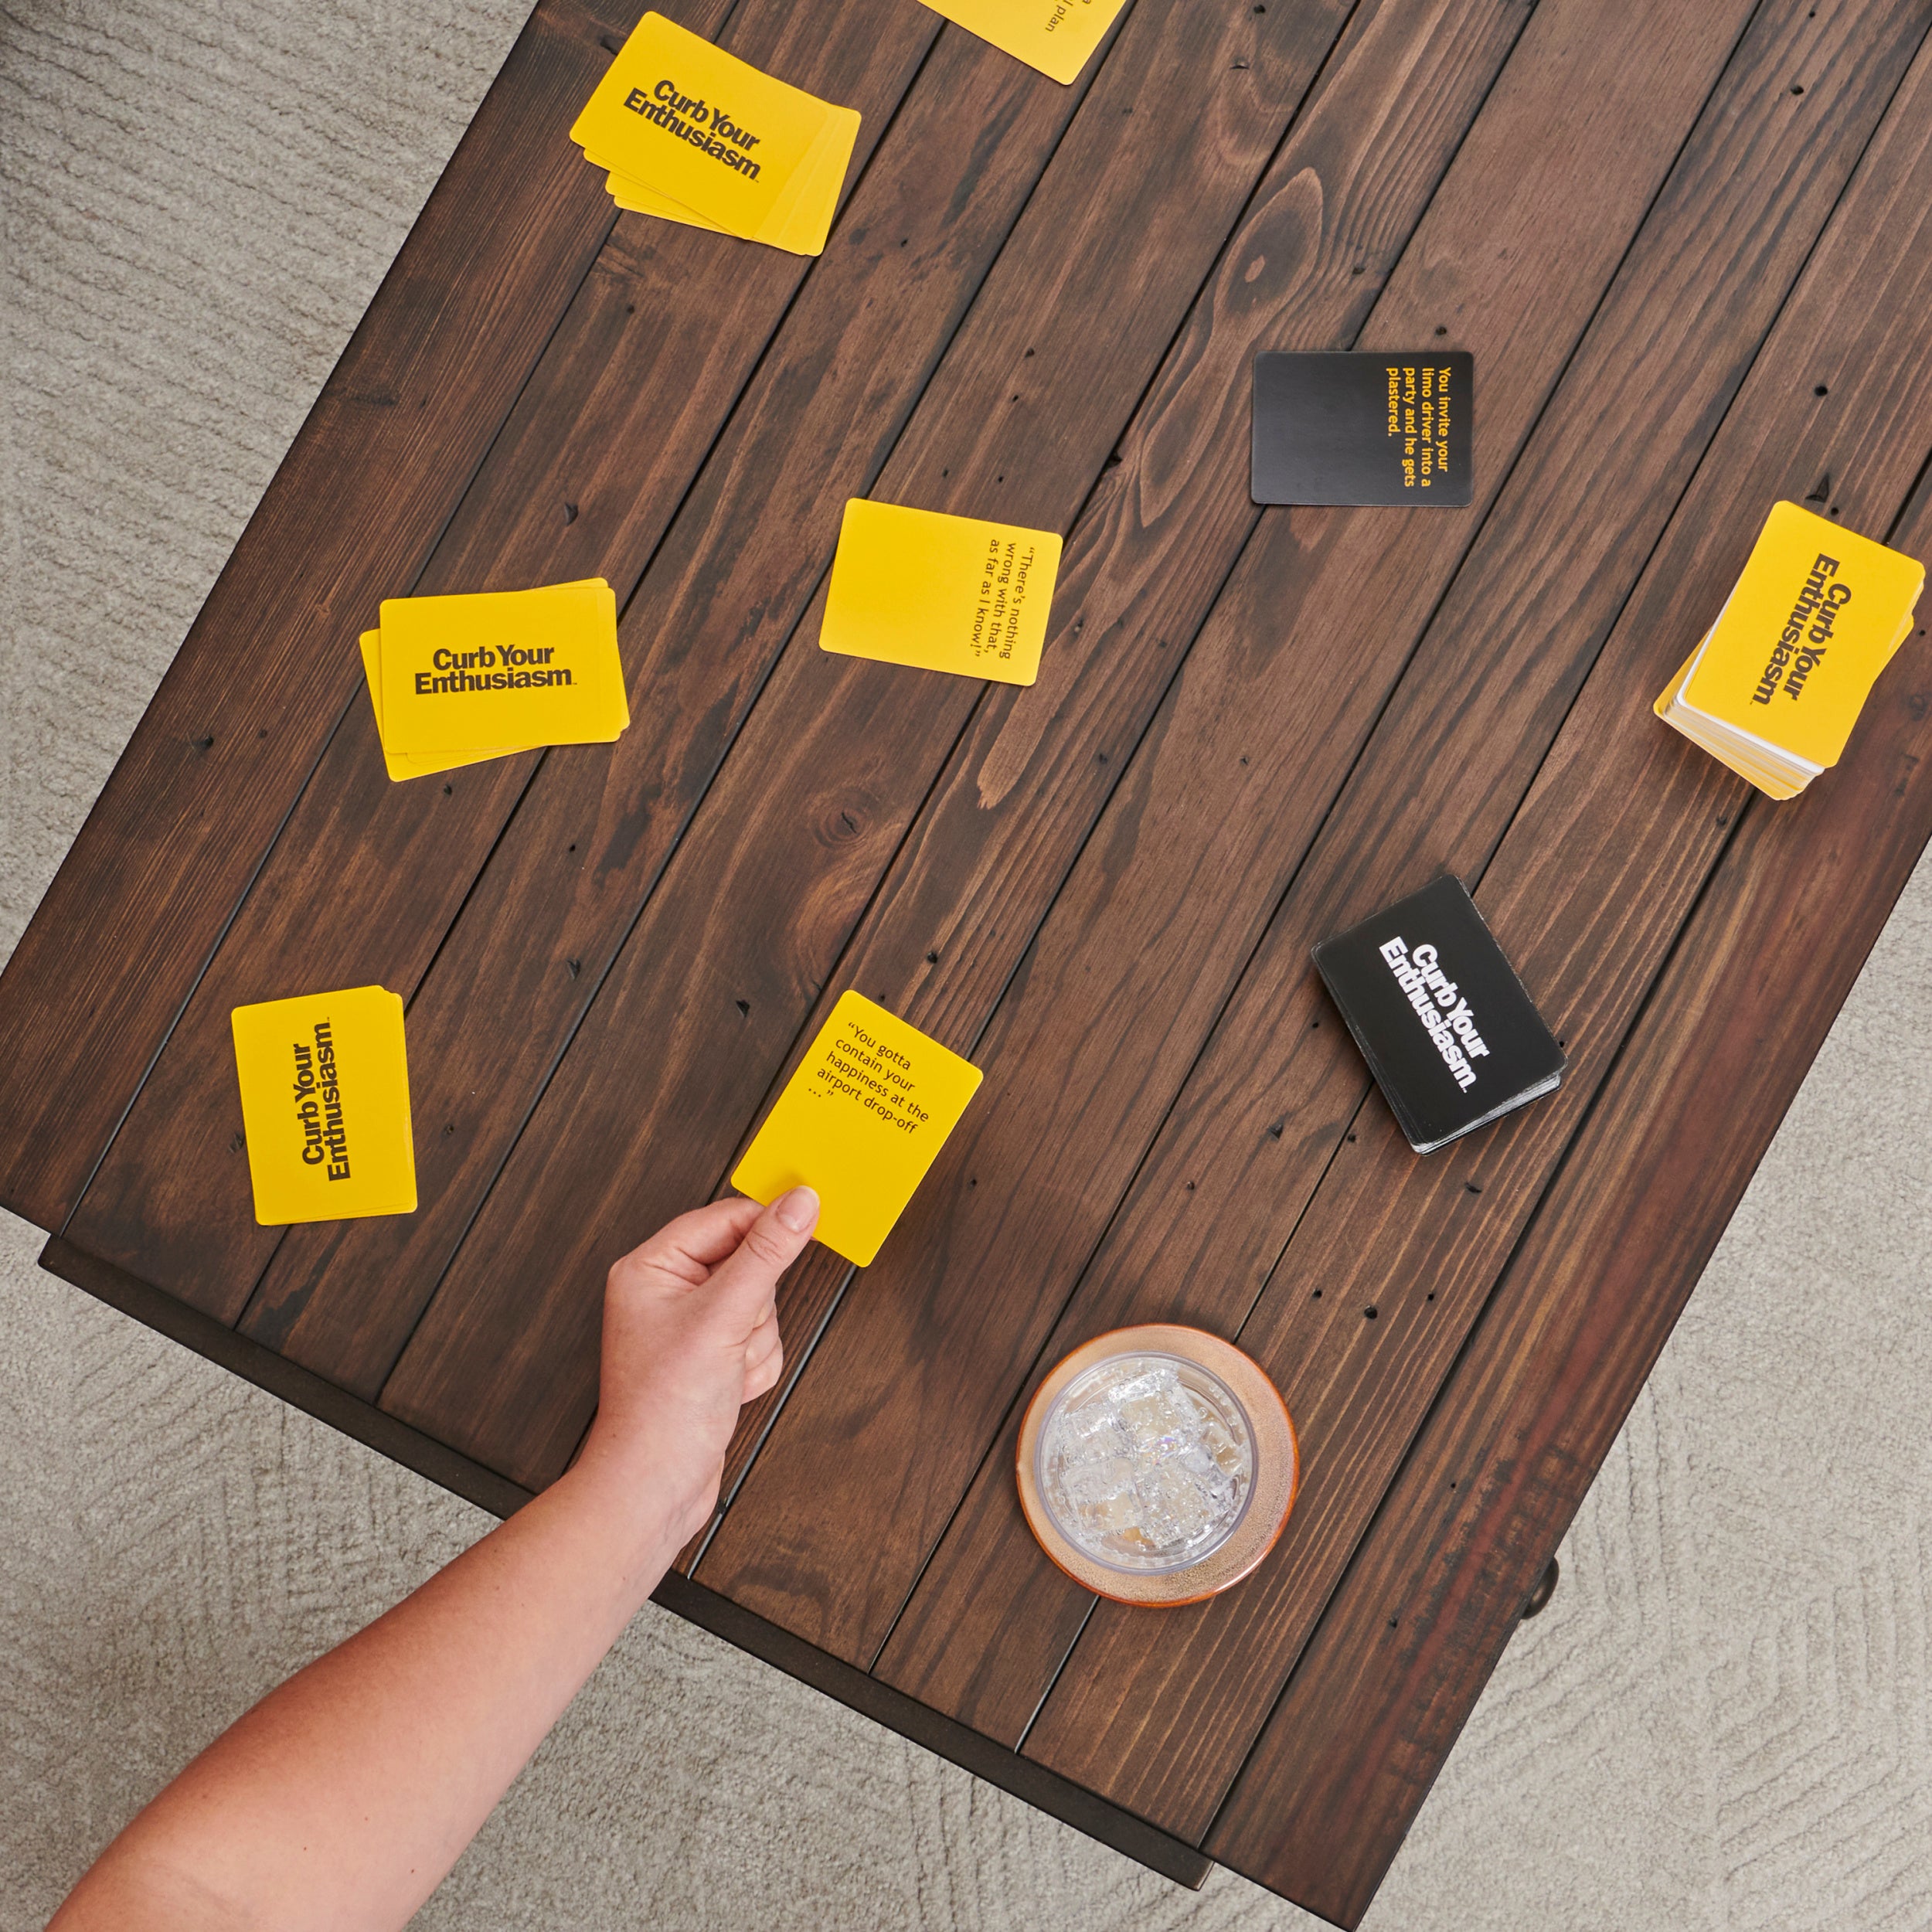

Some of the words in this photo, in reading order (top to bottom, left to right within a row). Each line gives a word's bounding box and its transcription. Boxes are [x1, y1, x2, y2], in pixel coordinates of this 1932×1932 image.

[1046, 5, 1066, 32] plan
[654, 80, 709, 123] Curb
[709, 108, 760, 151] Your
[1402, 367, 1417, 405] party
[1421, 367, 1435, 398] limo
[1438, 366, 1451, 393] You
[1386, 367, 1402, 437] plastered.
[1437, 396, 1451, 437] invite
[1404, 407, 1418, 434] and
[1421, 401, 1435, 444] driver
[1404, 437, 1418, 455] he
[1420, 447, 1434, 475] into
[1435, 440, 1448, 472] your
[1401, 458, 1417, 488] gets
[1421, 478, 1431, 488] a
[989, 539, 1000, 553] as
[985, 558, 999, 577] far
[997, 543, 1016, 584] wrong
[981, 580, 992, 595] as
[993, 588, 1008, 617] with
[1808, 583, 1851, 644] Curb
[983, 622, 1002, 653] that,
[998, 608, 1020, 660] nothing
[433, 646, 495, 671] Curb
[496, 645, 555, 666] Your
[1784, 648, 1826, 701] Your
[1413, 944, 1458, 1007] Curb
[1447, 997, 1490, 1058] Your
[293, 1043, 317, 1103] Your
[835, 1039, 883, 1073] contain
[883, 1069, 916, 1092] your
[876, 1045, 911, 1071] gotta
[817, 1068, 862, 1101] airport
[863, 1097, 919, 1134] drop-off
[826, 1050, 889, 1097] happiness
[890, 1094, 906, 1108] at
[906, 1102, 929, 1122] the
[297, 1101, 325, 1165] Curb
